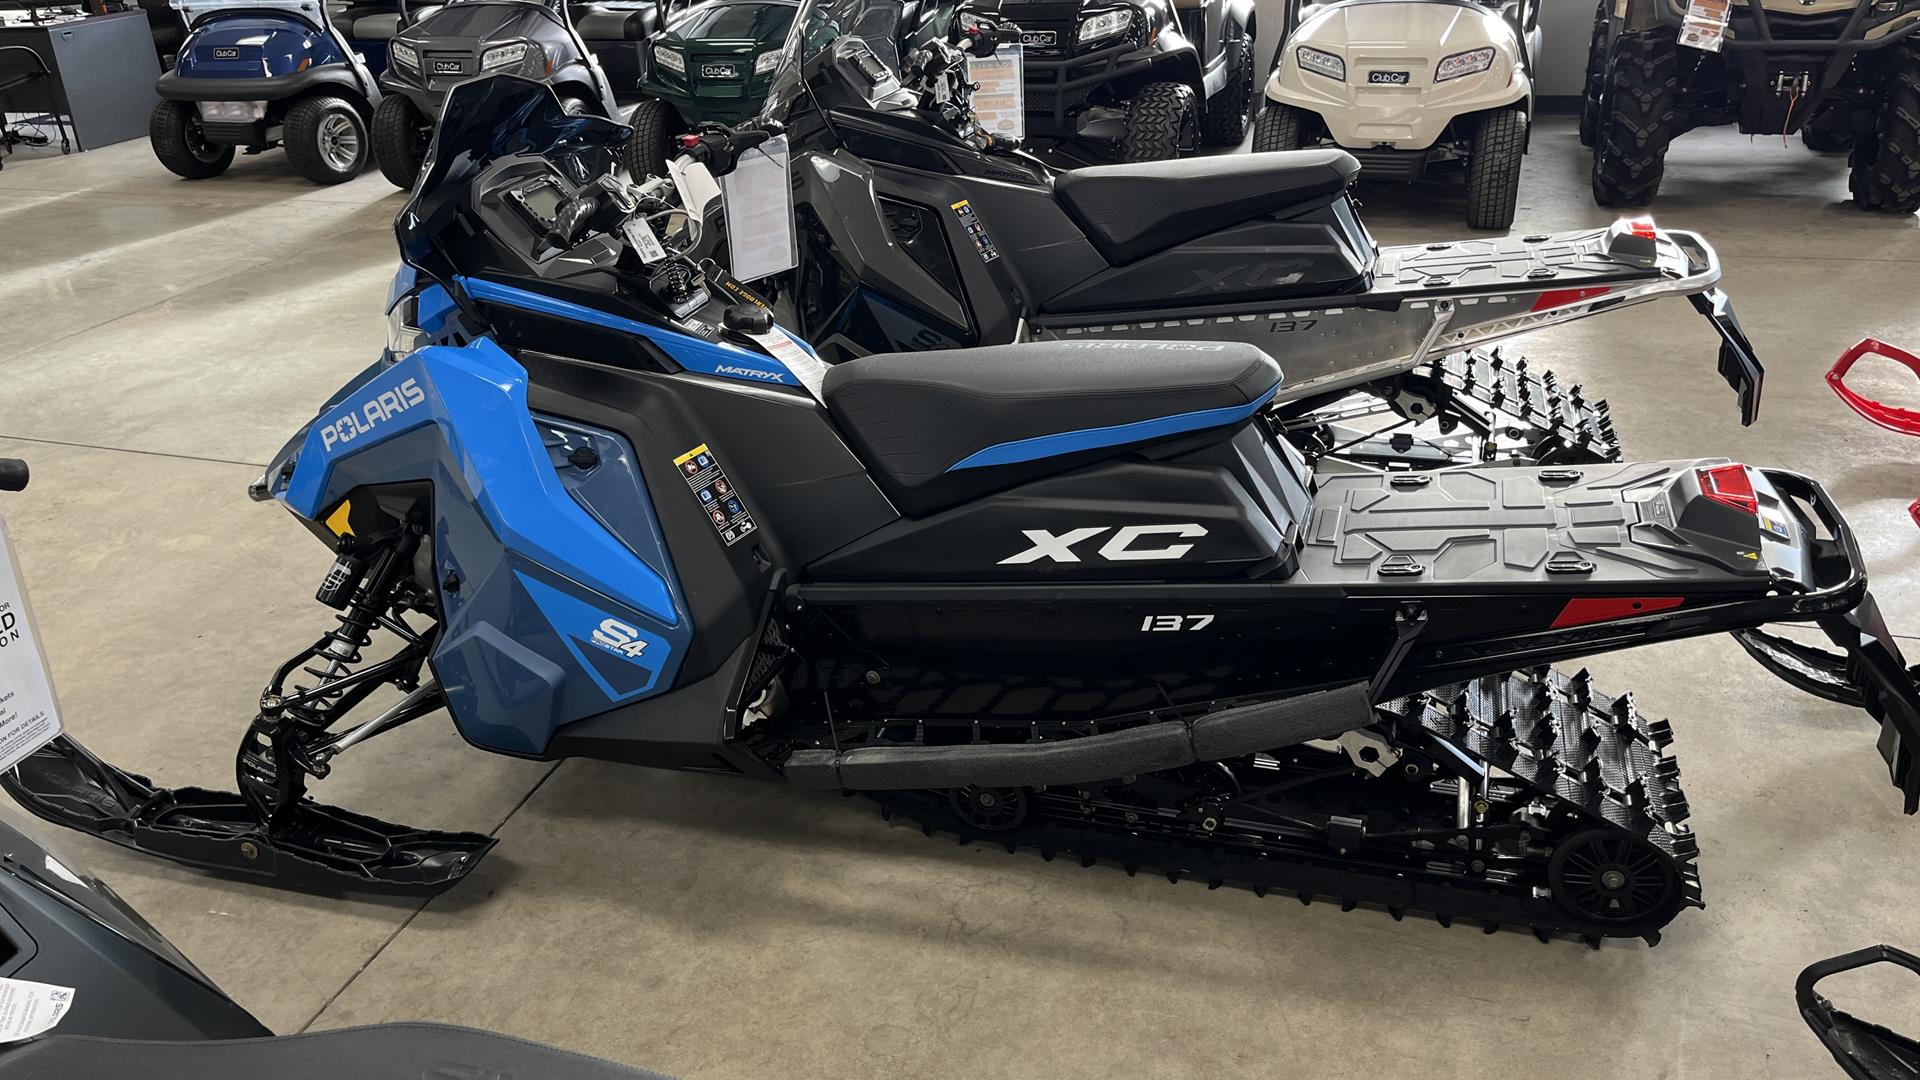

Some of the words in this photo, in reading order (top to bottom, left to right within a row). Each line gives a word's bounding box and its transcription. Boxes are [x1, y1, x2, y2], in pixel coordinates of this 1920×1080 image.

[1269, 319, 1318, 333] 137
[714, 364, 784, 384] MATRYX
[319, 377, 425, 453] POLARIS
[995, 523, 1209, 565] XC
[1140, 614, 1215, 631] 137
[21, 710, 45, 729] DETAILS
